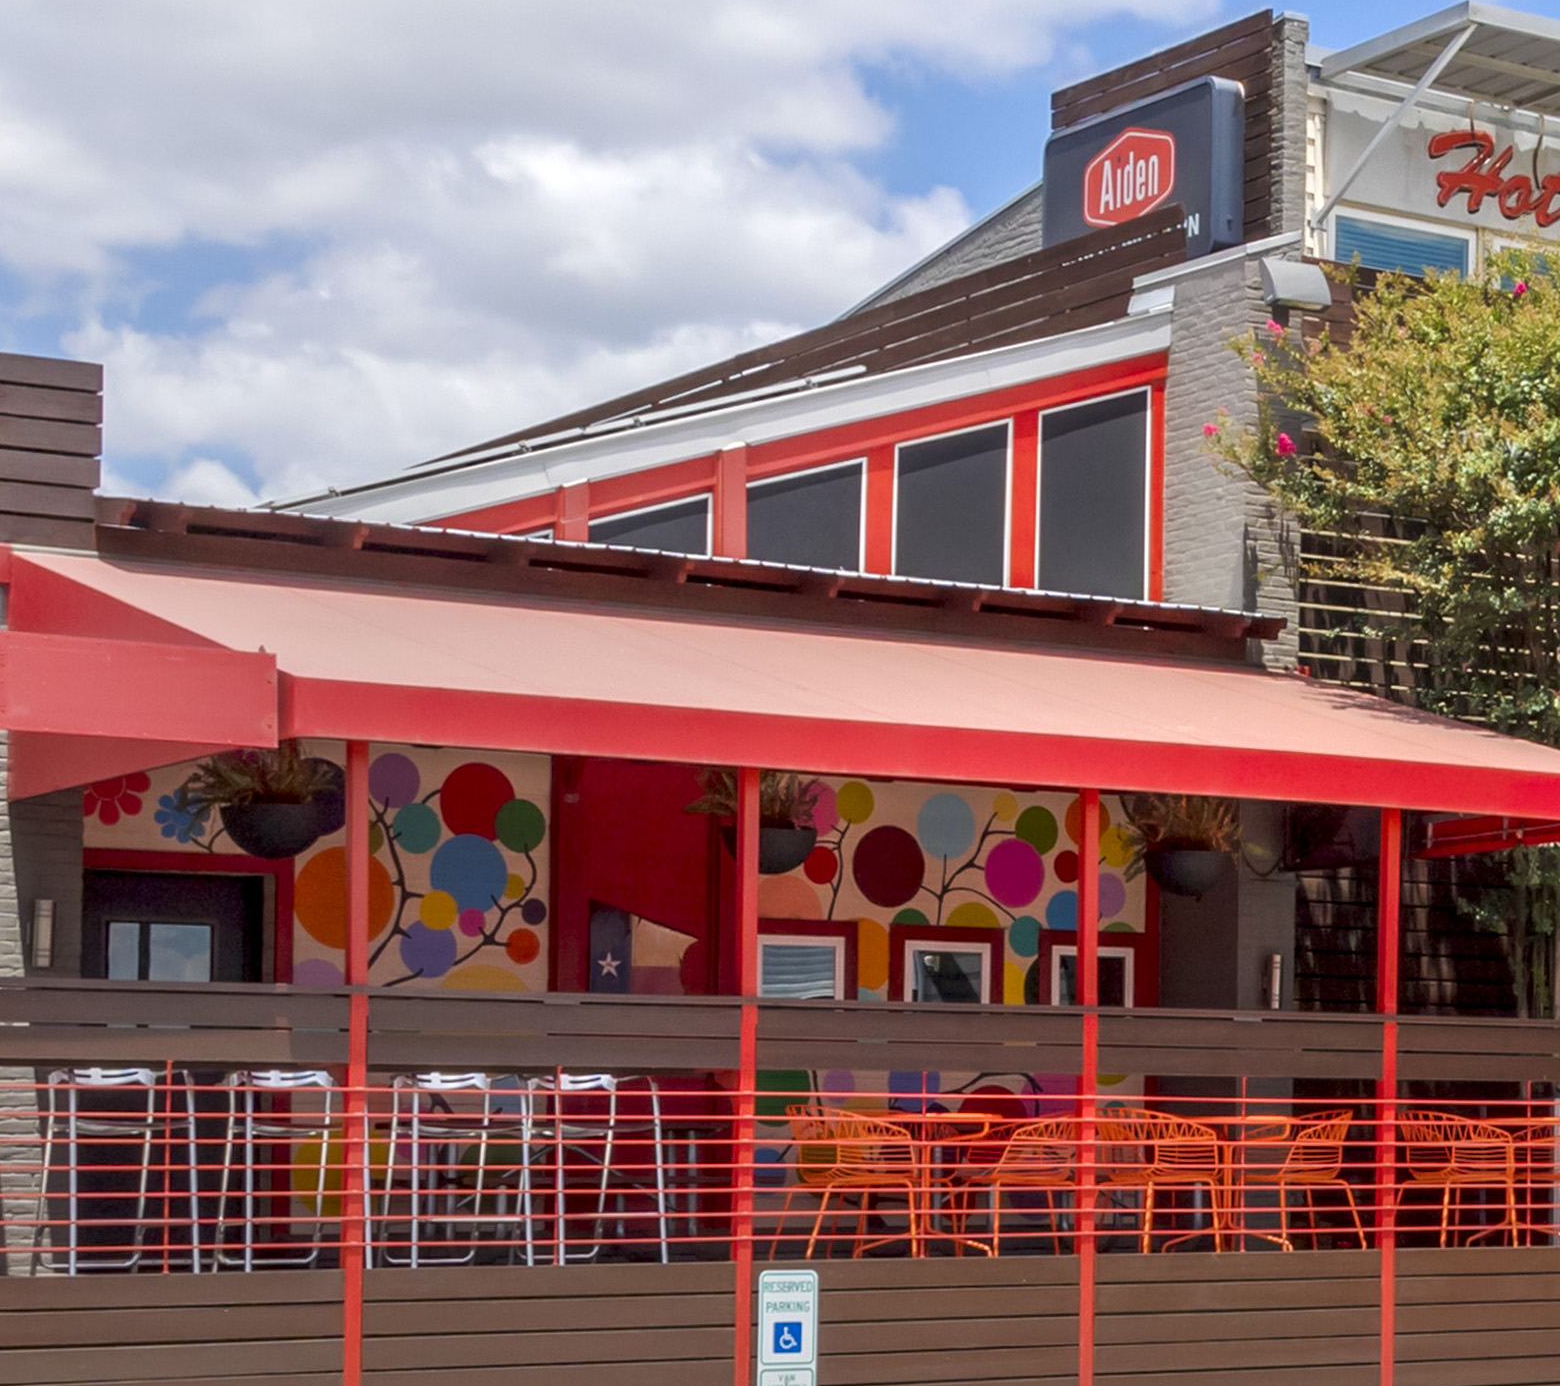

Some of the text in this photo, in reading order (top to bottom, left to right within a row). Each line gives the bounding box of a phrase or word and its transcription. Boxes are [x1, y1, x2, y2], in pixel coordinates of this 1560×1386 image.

[1099, 151, 1159, 214] Aiden
[763, 1280, 813, 1293] RESERVED
[766, 1300, 810, 1313] PARKING
